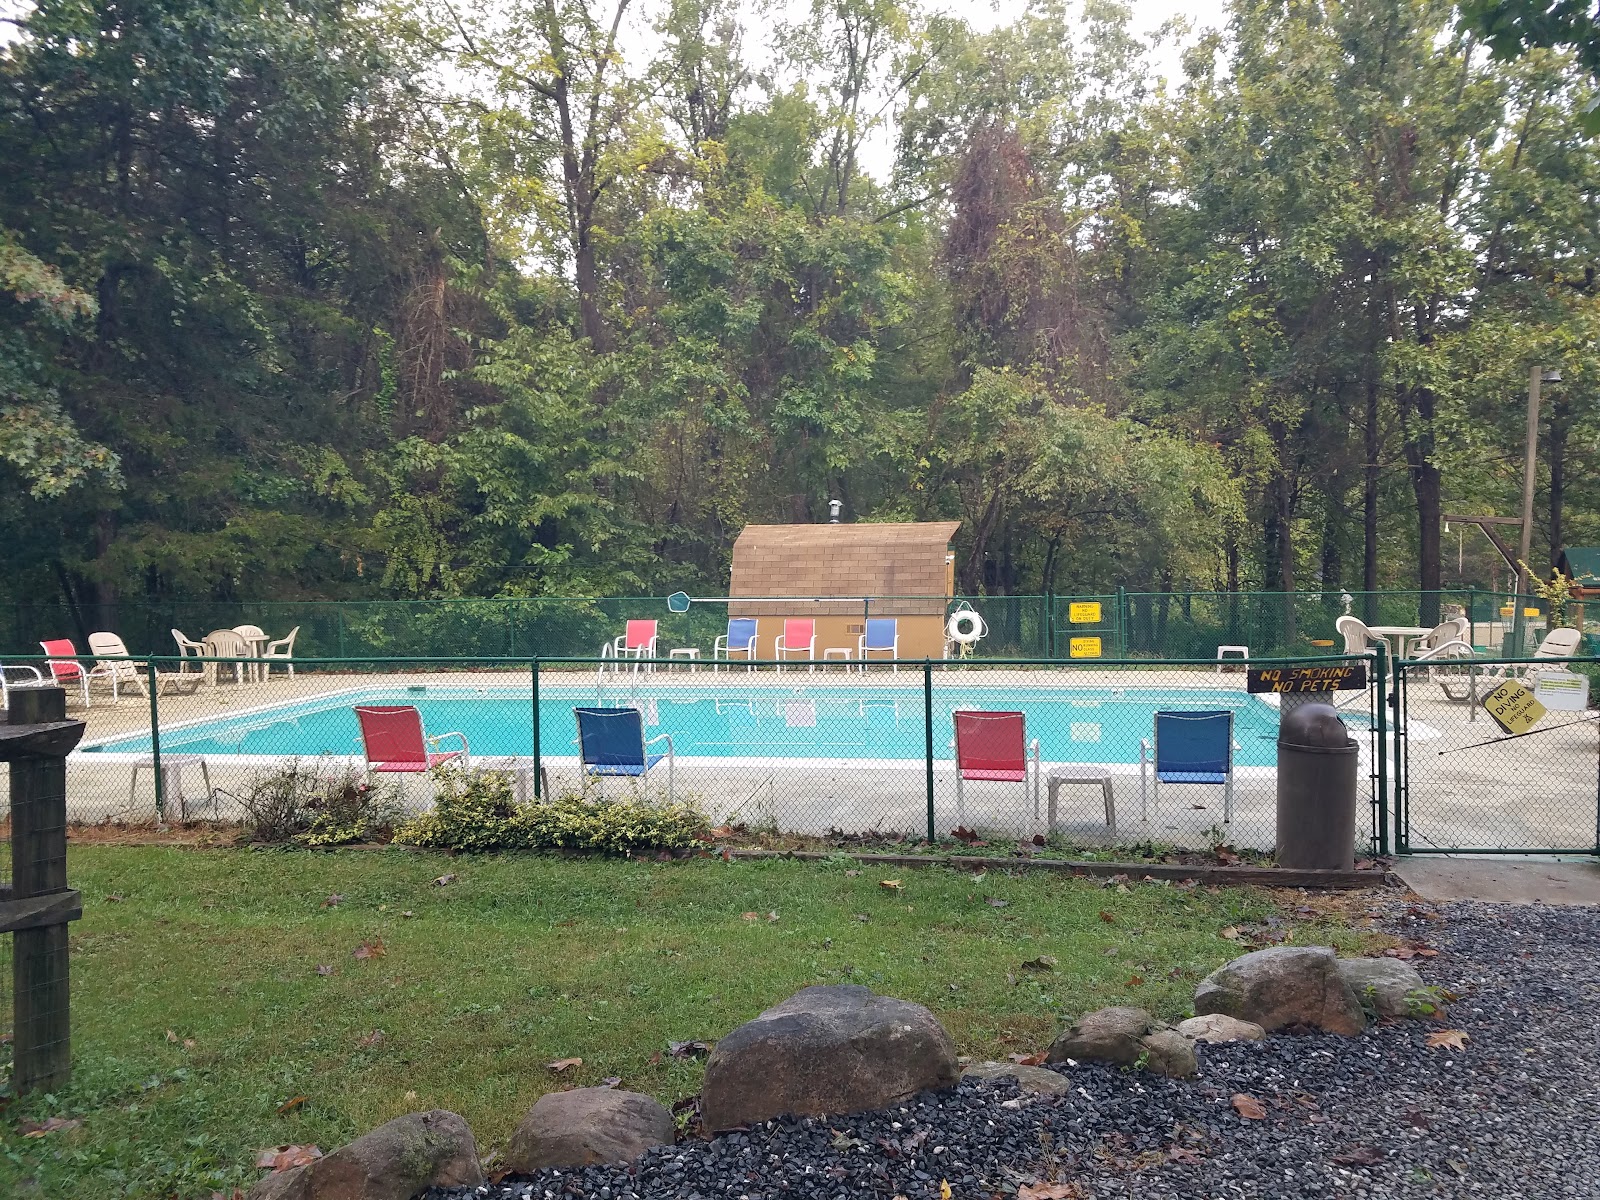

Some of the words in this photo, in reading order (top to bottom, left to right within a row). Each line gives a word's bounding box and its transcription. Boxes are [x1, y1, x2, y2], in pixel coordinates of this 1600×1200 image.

[1260, 670, 1281, 681] NO
[1289, 667, 1354, 680] SMOKING
[1272, 681, 1293, 693] NO
[1300, 679, 1341, 691] PETS
[1494, 688, 1508, 702] NO
[1496, 688, 1525, 715] DIVING
[1506, 700, 1535, 724] LIFEGUARD
[1510, 704, 1520, 712] NO
